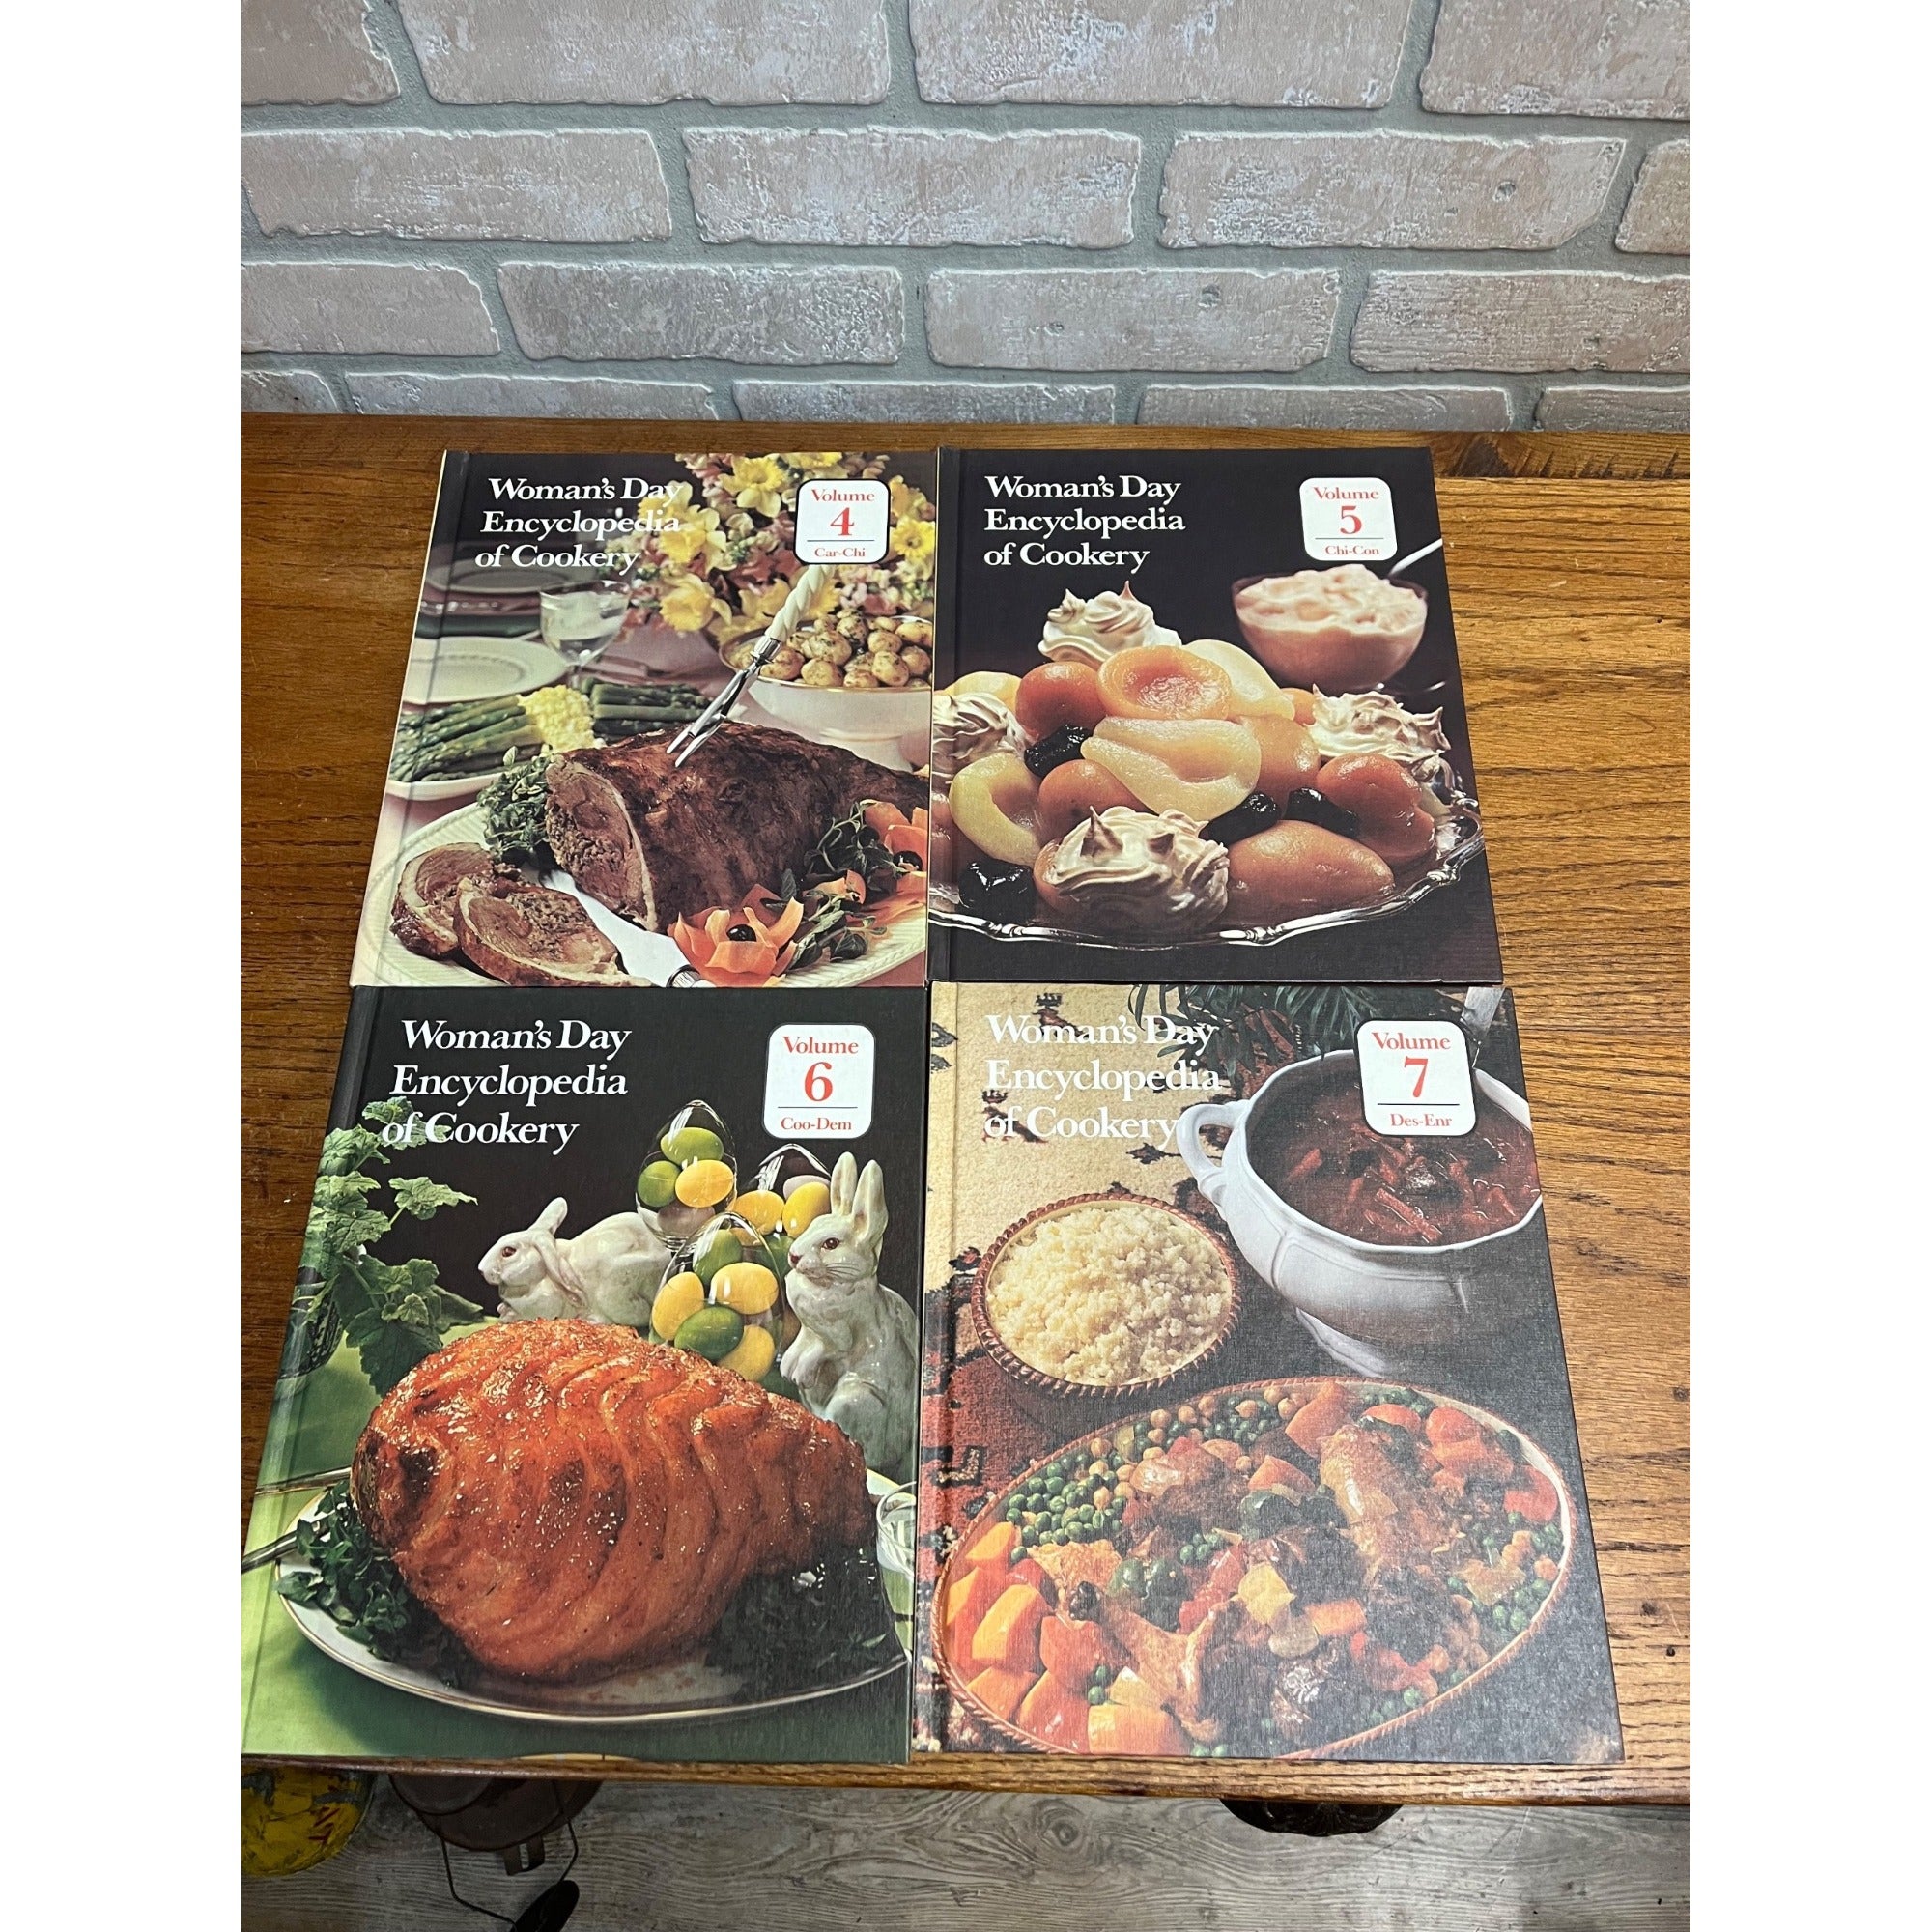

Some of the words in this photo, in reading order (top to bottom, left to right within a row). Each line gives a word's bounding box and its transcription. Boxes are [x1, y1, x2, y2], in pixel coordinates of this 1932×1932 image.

[488, 477, 615, 500] Woman's
[620, 477, 683, 506] Day
[810, 489, 875, 504] Volume
[984, 476, 1114, 499] Woman's
[1119, 476, 1181, 503] Day
[1313, 486, 1379, 501] Volume
[481, 511, 680, 540] Encyclopedia
[829, 508, 855, 536] 4
[984, 509, 1185, 539] Encyclopedia
[1339, 505, 1362, 535] 5
[475, 544, 506, 568] of
[511, 544, 639, 574] Cookery
[814, 547, 866, 558] Car-Chi
[983, 543, 1015, 565] of
[1019, 543, 1151, 573] Cookery
[1324, 544, 1379, 556] Chi-Con
[402, 1019, 552, 1050] Woman's
[556, 1019, 632, 1058] Day
[782, 1036, 859, 1056] Volume
[985, 1014, 1137, 1045] Woman's
[1144, 1014, 1219, 1055] Day
[1371, 1032, 1451, 1051] Volume
[390, 1064, 628, 1105] Encyclopedia
[803, 1061, 834, 1102] 6
[985, 1060, 1221, 1101] Encyclopedia
[1402, 1056, 1429, 1099] 7
[382, 1112, 419, 1146] of
[425, 1112, 579, 1156] Cookery
[780, 1116, 853, 1132] Coo-Dem
[983, 1106, 1020, 1139] of
[1026, 1106, 1177, 1151] Cookery
[1390, 1112, 1453, 1128] Des-Enr
